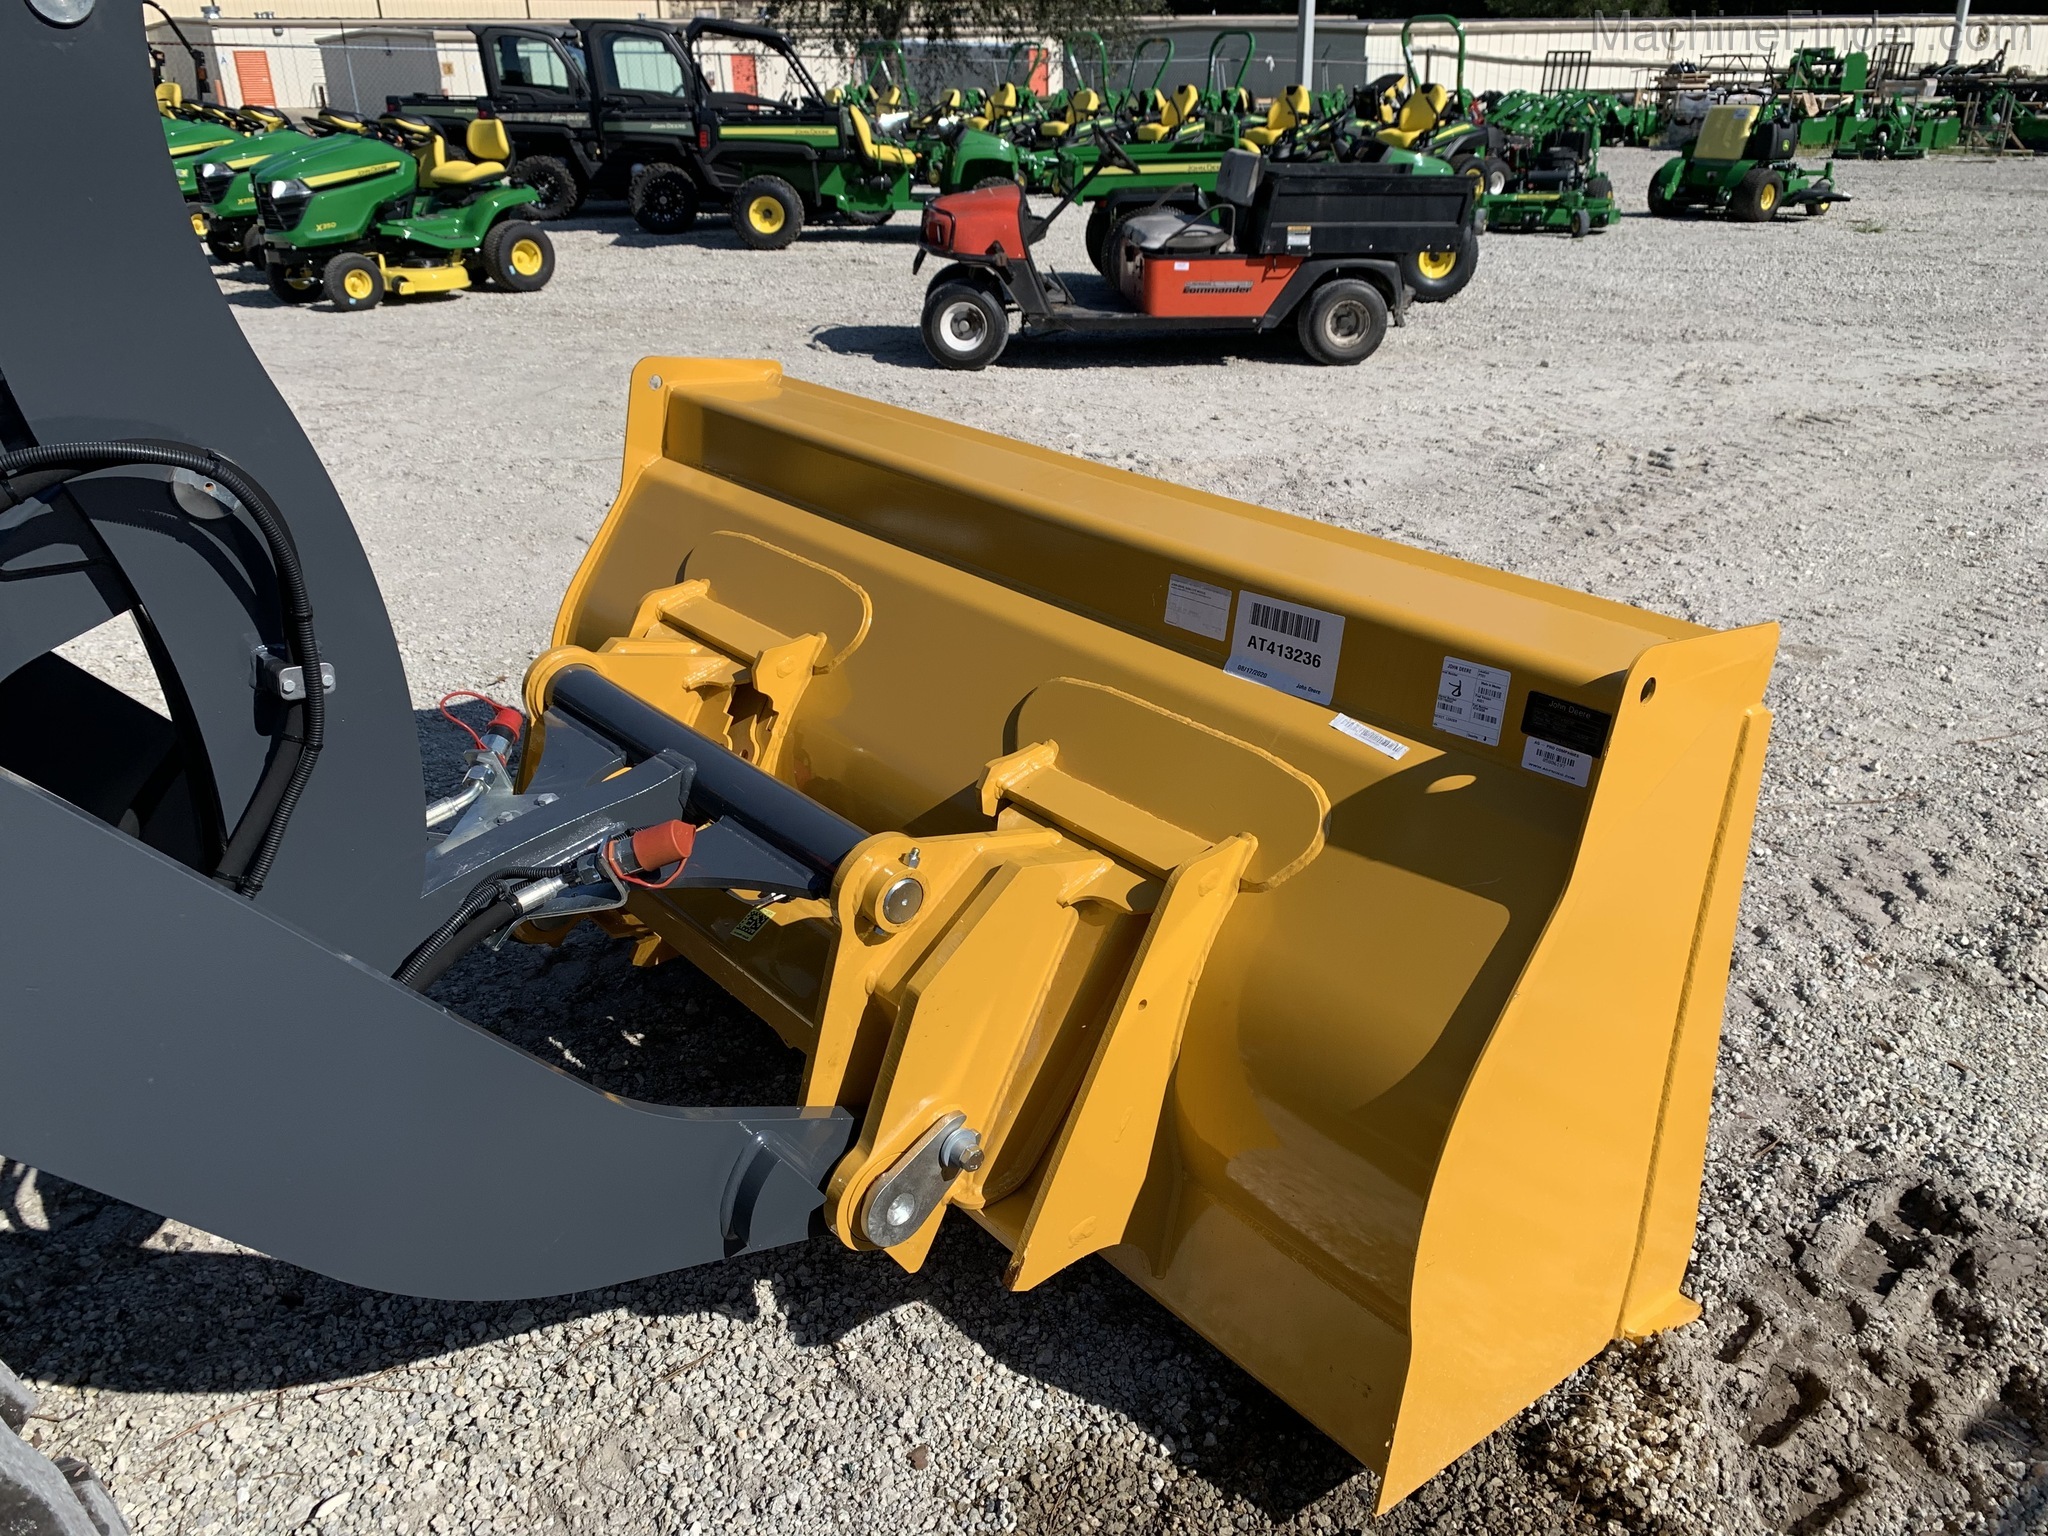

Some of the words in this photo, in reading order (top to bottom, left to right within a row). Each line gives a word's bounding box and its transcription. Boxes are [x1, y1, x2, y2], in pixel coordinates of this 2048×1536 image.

[1183, 284, 1252, 294] Commander
[1247, 635, 1322, 669] AT413236
[1459, 666, 1472, 674] DEERE
[1295, 683, 1307, 691] John
[1307, 686, 1322, 695] Deere
[1548, 700, 1567, 711] John
[1568, 705, 1591, 719] Deere
